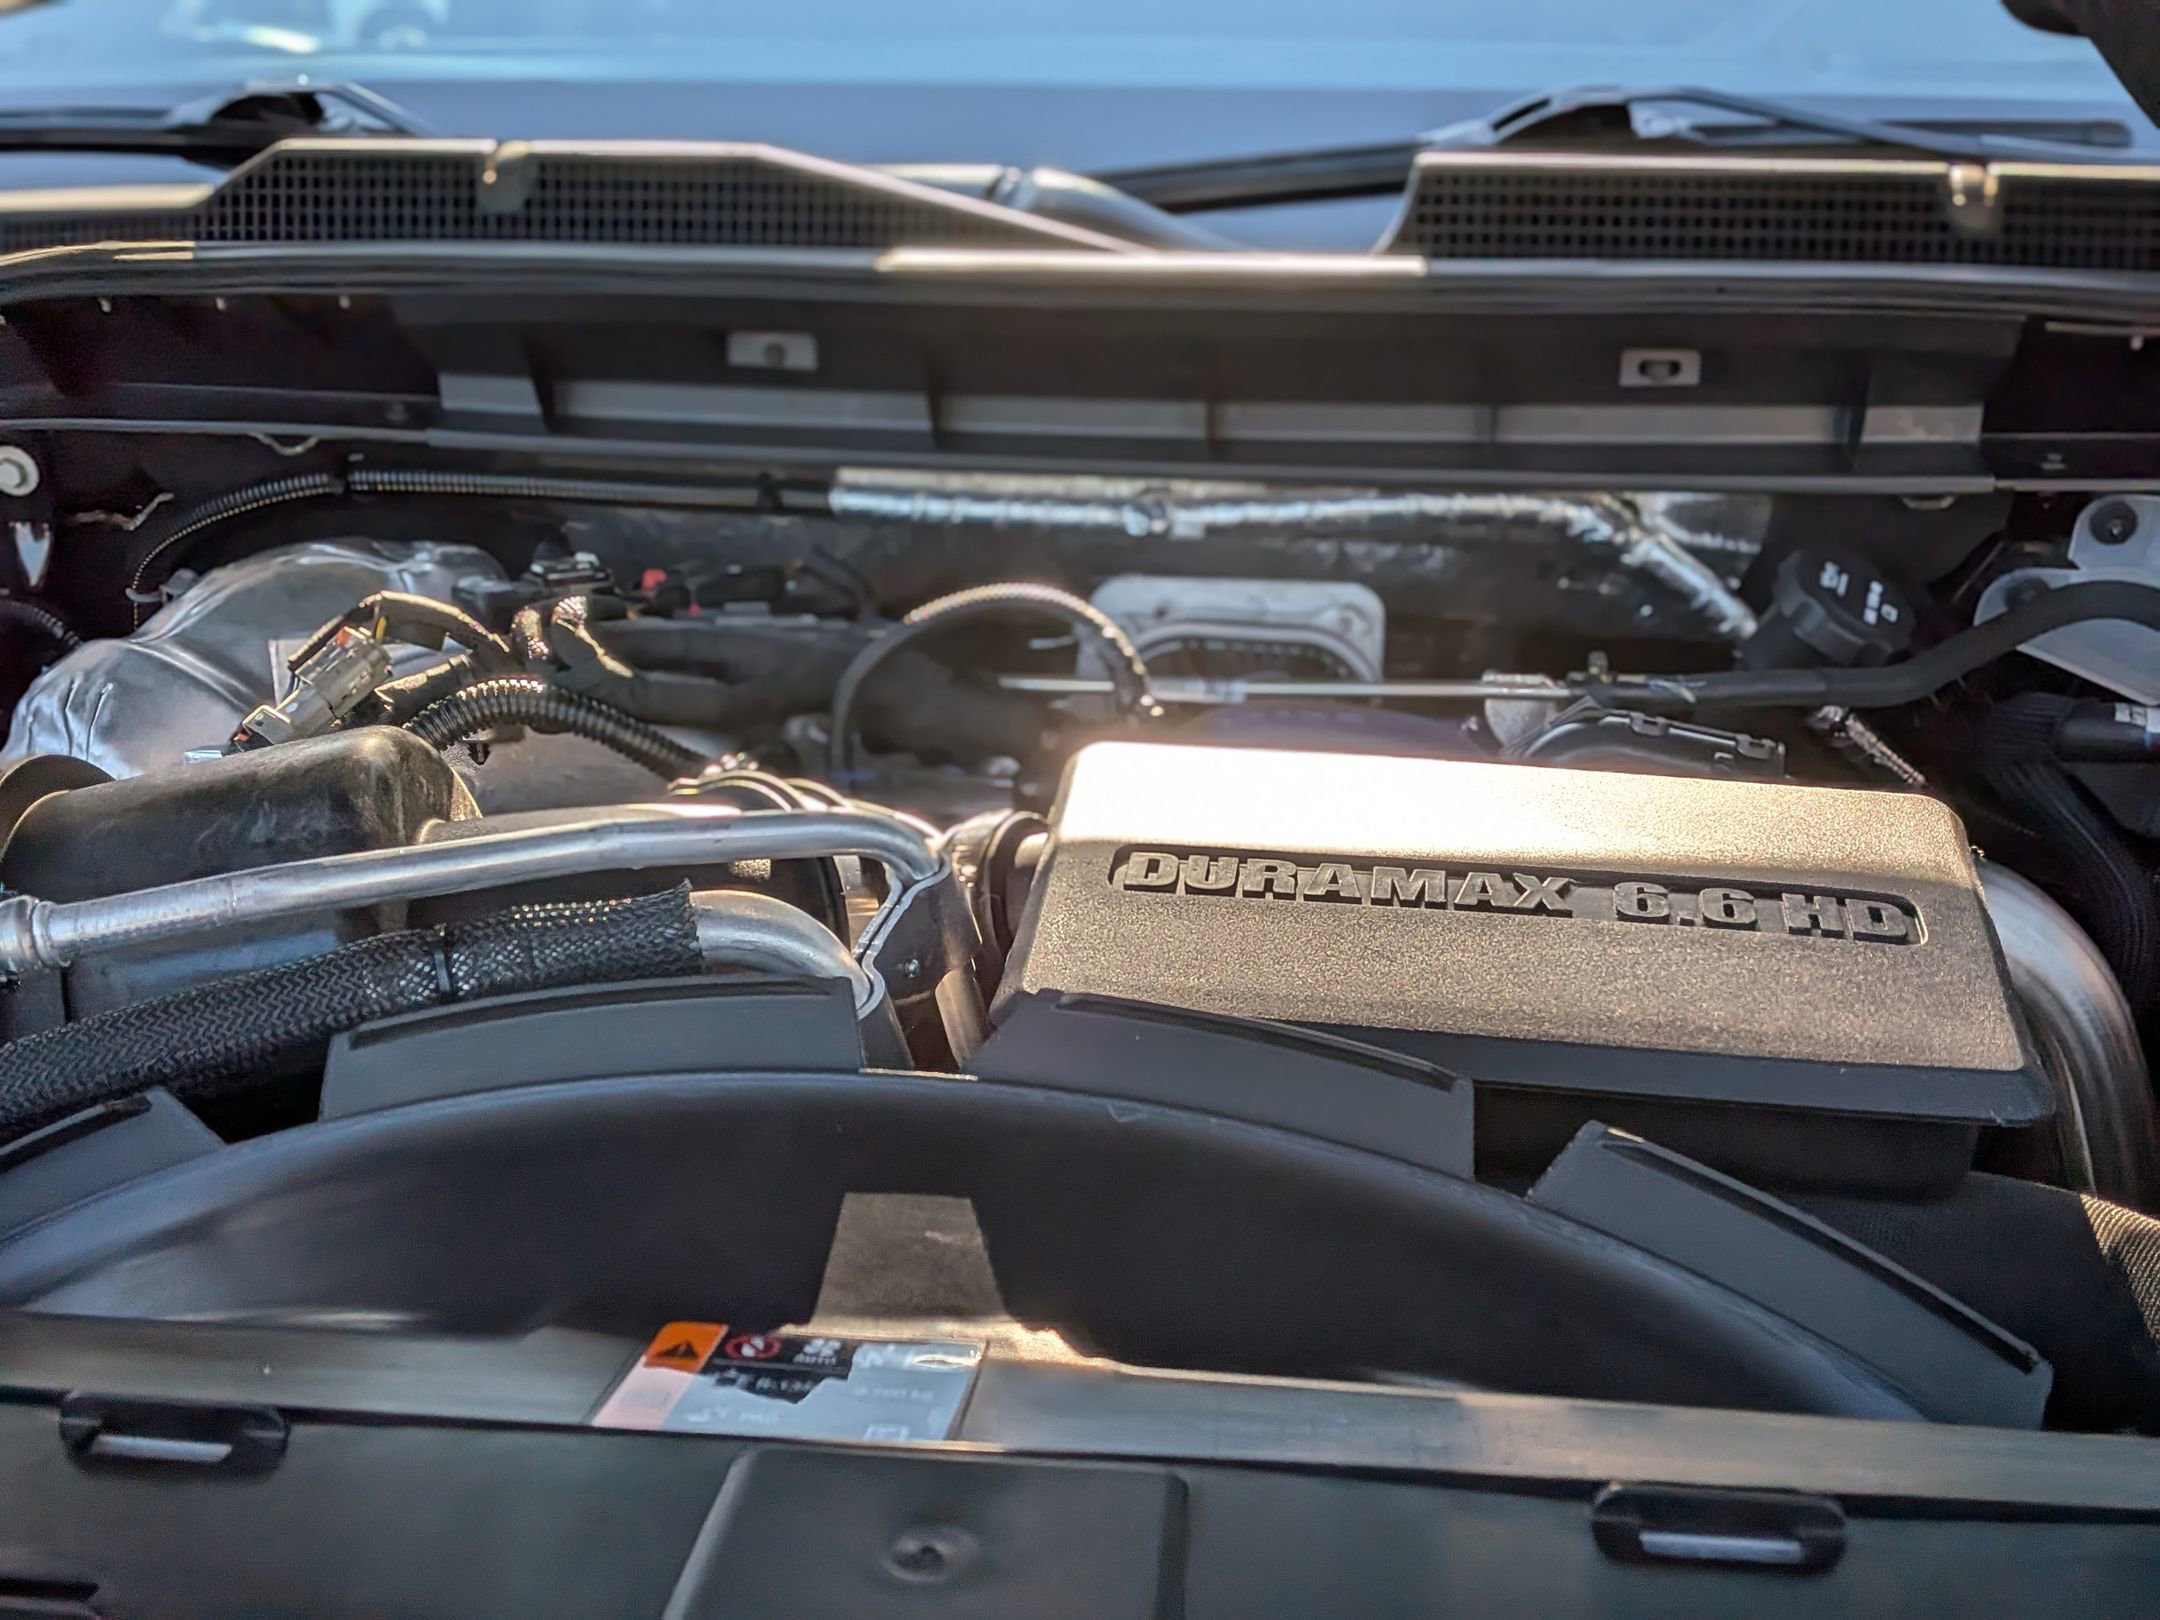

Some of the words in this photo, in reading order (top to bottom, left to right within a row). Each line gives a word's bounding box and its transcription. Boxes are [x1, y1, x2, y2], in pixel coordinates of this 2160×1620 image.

[1123, 851, 1573, 919] DURAMAX
[1613, 881, 1757, 932] 6.6
[1782, 892, 1907, 940] HD
